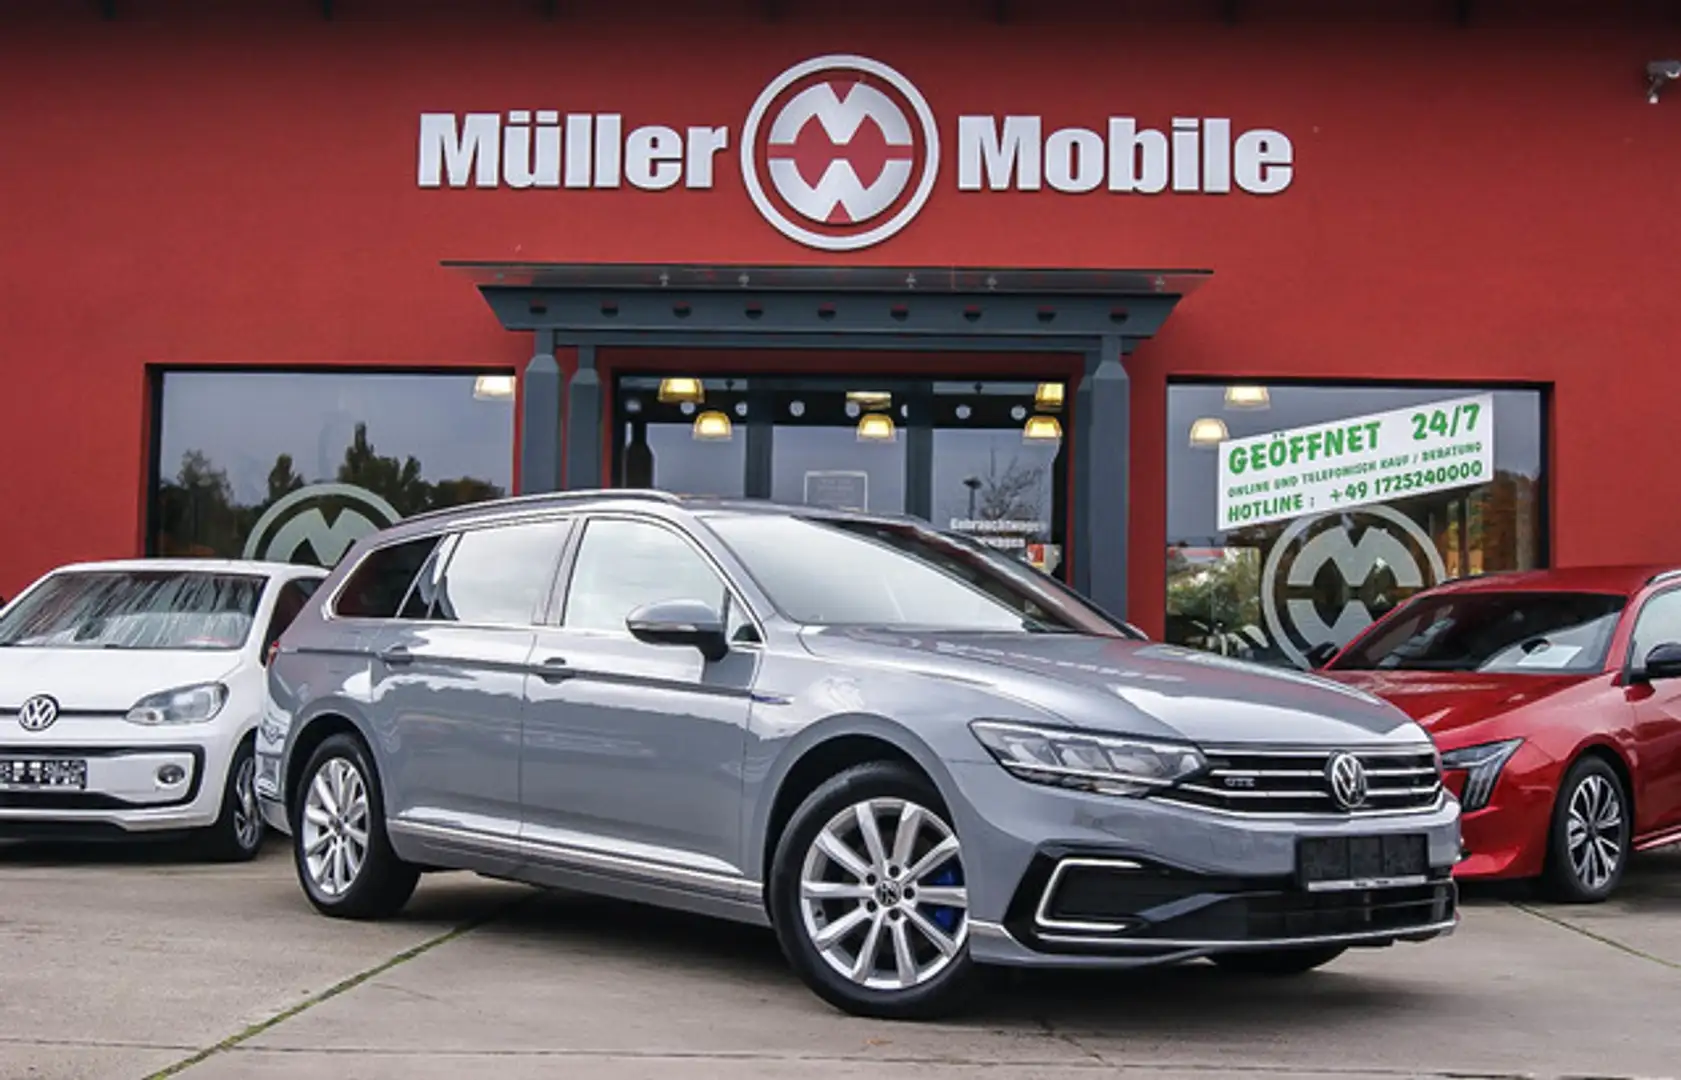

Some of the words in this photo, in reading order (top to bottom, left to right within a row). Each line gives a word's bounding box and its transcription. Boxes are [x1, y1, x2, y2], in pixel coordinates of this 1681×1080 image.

[418, 110, 728, 189] Müller
[958, 115, 1294, 194] Mobile
[1227, 480, 1270, 498] ONLINE
[1274, 475, 1298, 491] UND
[1302, 459, 1377, 485] TELEFONISCH
[1380, 455, 1409, 471] KAUF
[1422, 441, 1483, 463] BERATUNG
[1228, 421, 1381, 475] GEÖFFNET
[1411, 403, 1480, 440] 24/7
[1329, 480, 1368, 503] +49
[1374, 460, 1483, 495] 1725240000
